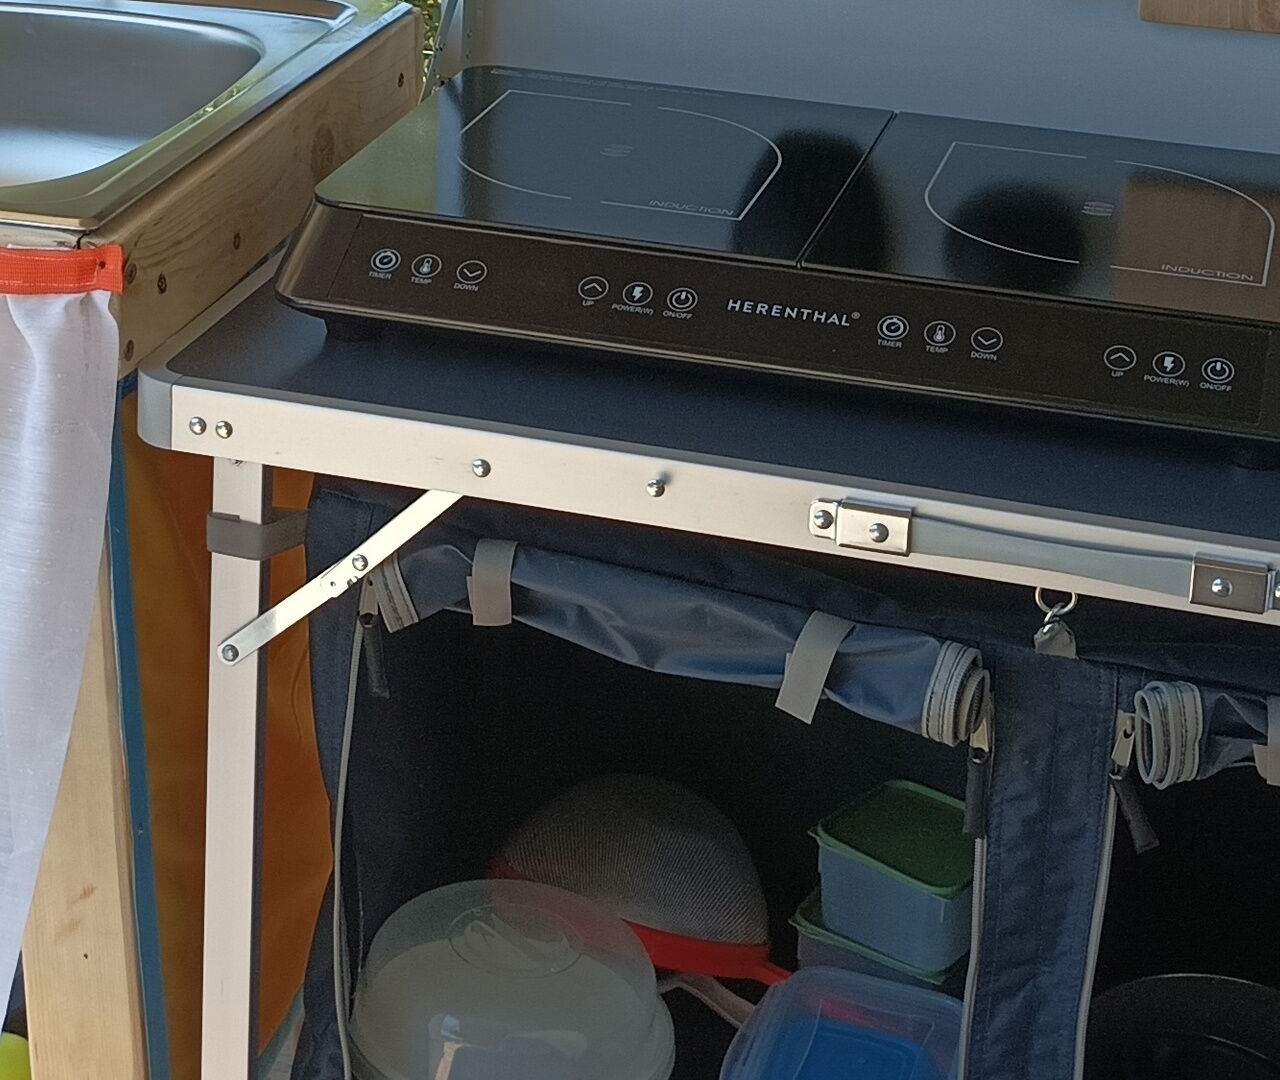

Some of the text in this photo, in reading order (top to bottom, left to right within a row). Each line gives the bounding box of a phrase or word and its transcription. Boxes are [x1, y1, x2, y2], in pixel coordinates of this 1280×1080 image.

[649, 199, 734, 216] INDUCTION
[369, 271, 393, 280] TIMER
[1160, 263, 1254, 281] INDUCTION
[453, 283, 480, 292] DOWN
[582, 299, 595, 307] UP
[611, 303, 654, 316] POWER(W)
[662, 310, 694, 320] ON/OFF
[877, 338, 903, 349] TIMER
[925, 345, 949, 354] TEMP
[970, 351, 998, 361] DOWN
[1143, 374, 1191, 388] POWER(W)
[1199, 382, 1233, 392] ON/OFF
